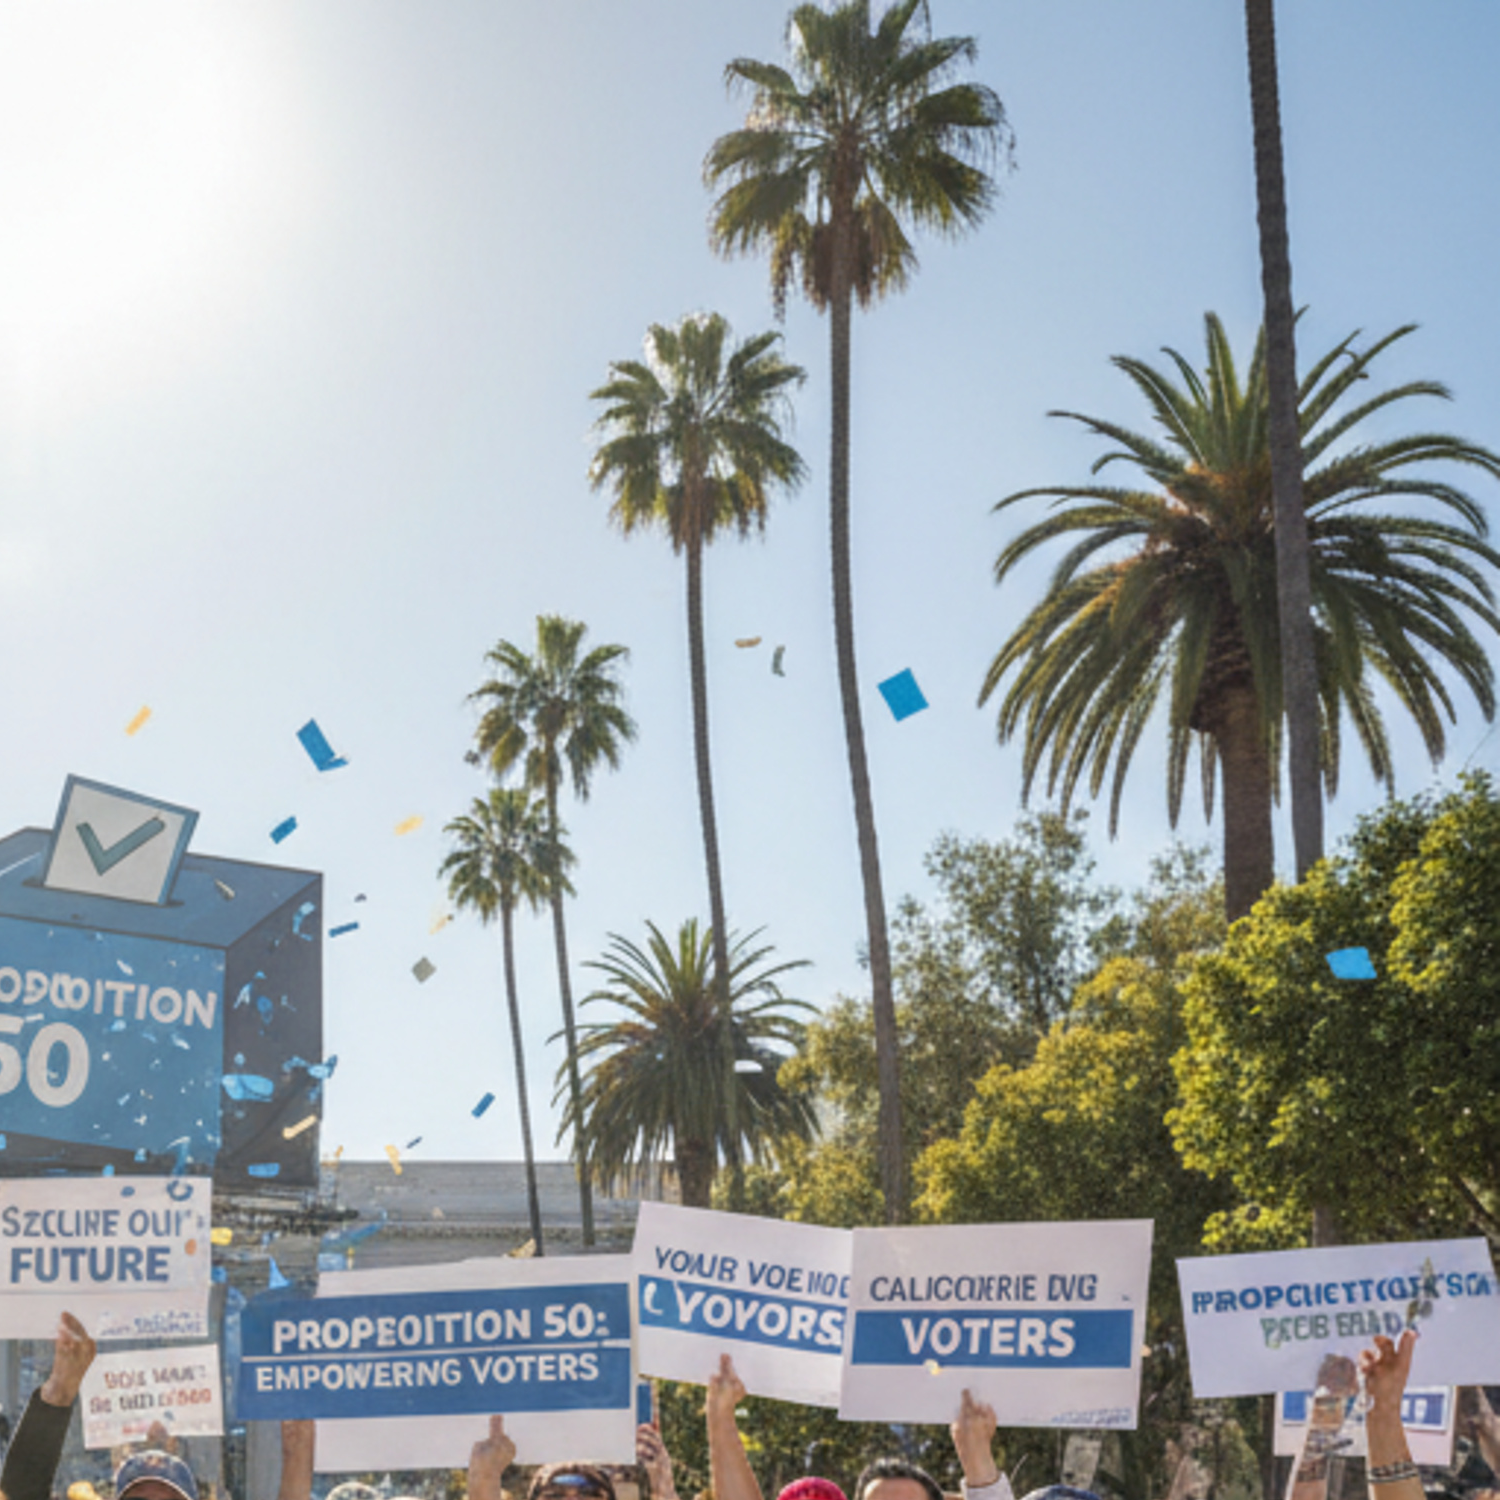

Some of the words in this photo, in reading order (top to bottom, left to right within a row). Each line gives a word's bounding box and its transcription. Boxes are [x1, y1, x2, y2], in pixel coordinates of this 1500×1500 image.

[9, 1245, 172, 1284] FUTURE
[900, 1316, 1076, 1357] VOTERS
[468, 1352, 600, 1385] VOTERS
